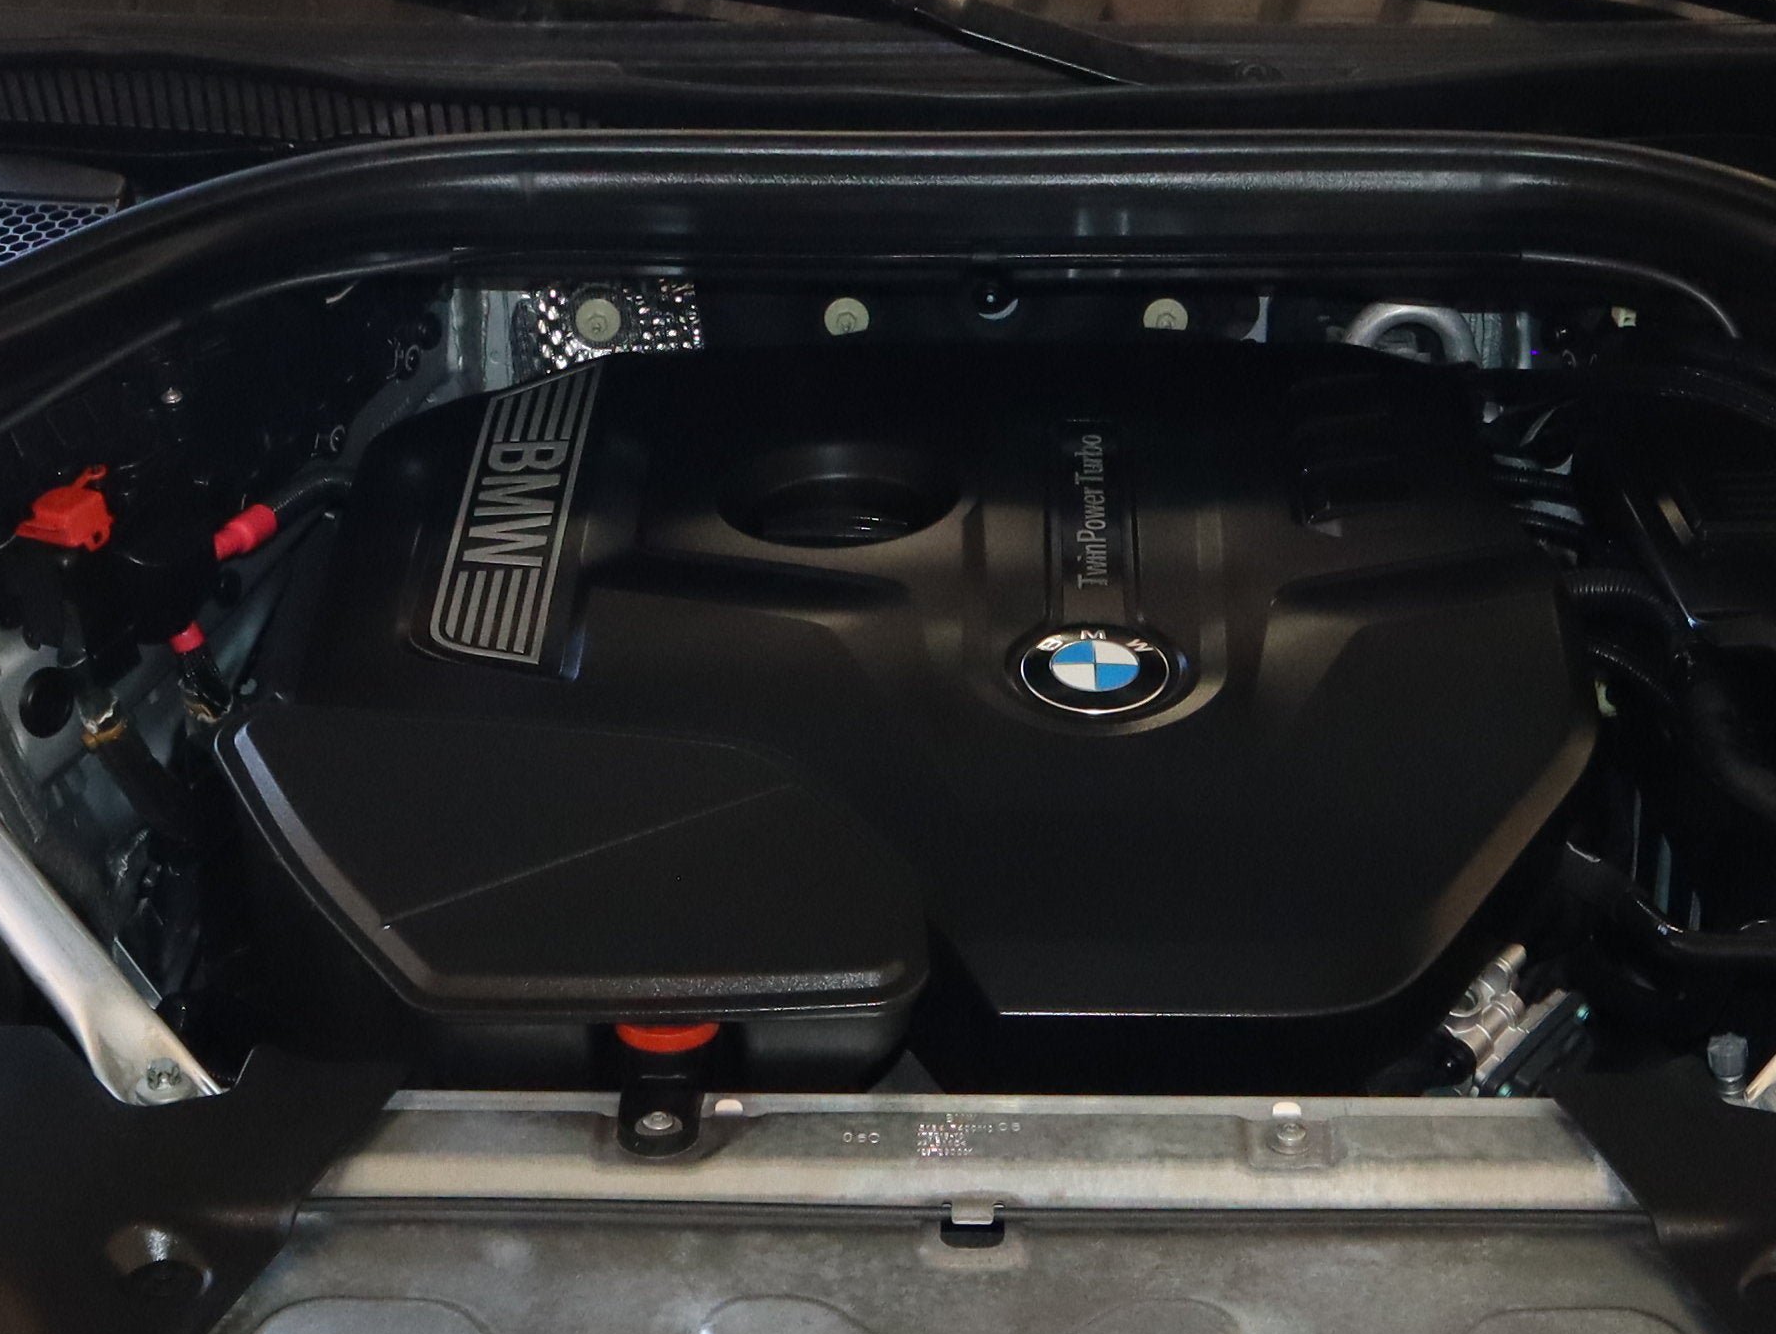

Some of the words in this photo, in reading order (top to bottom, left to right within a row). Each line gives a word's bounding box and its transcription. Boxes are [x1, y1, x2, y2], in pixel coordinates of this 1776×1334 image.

[1075, 434, 1105, 485] Turbo
[462, 440, 570, 568] BMW
[1077, 486, 1109, 590] TwinPower
[1035, 629, 1154, 653] BMW
